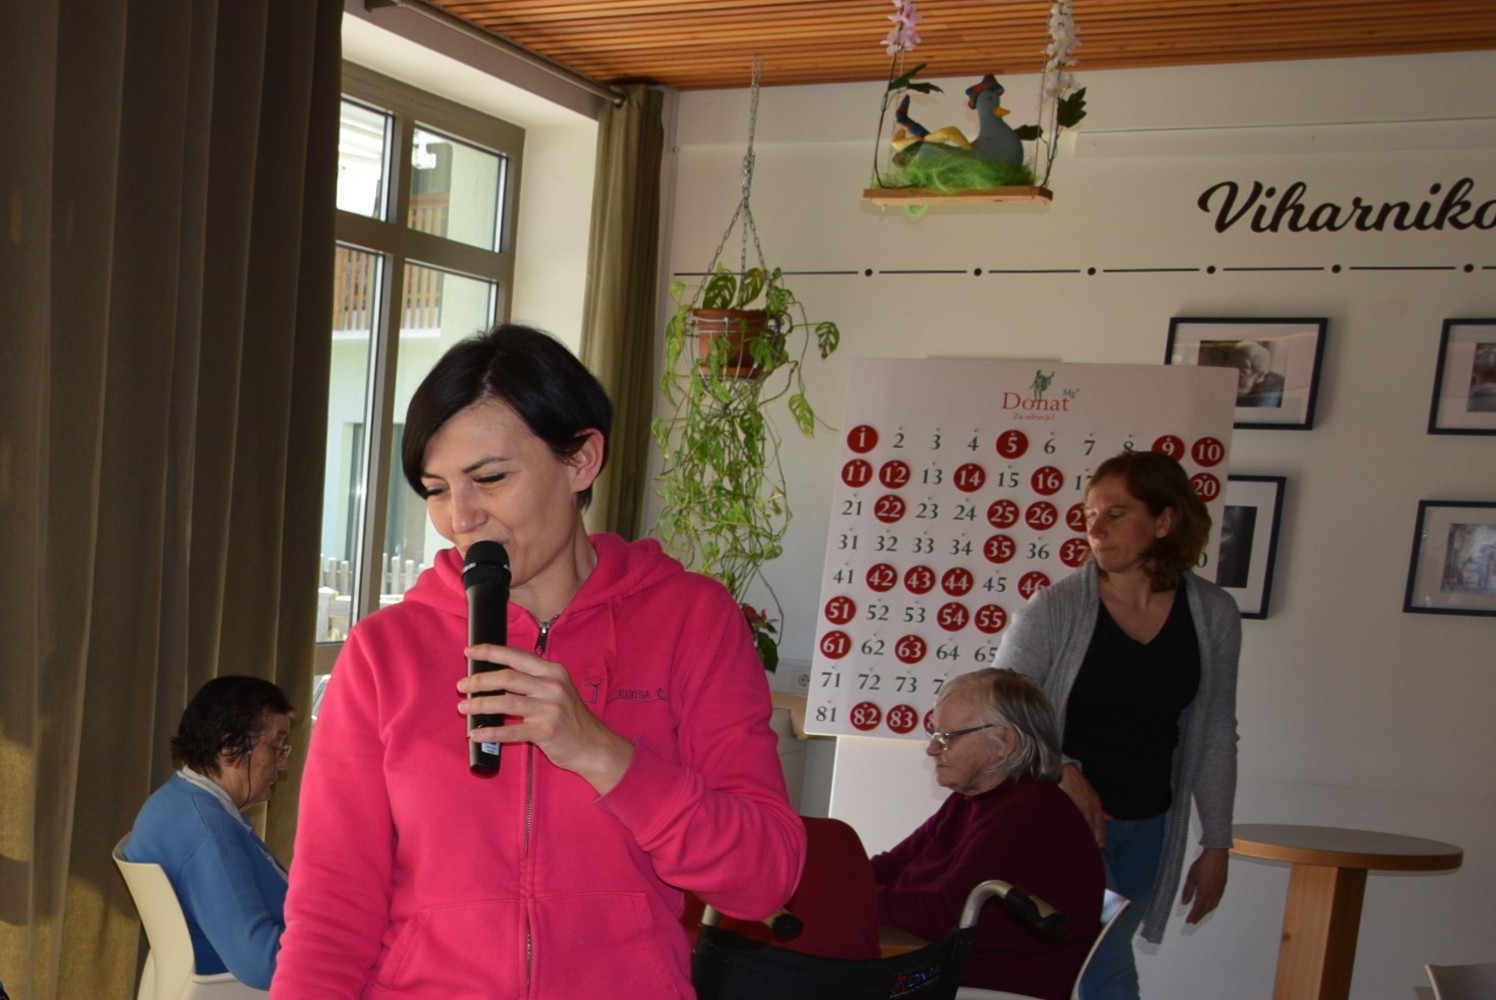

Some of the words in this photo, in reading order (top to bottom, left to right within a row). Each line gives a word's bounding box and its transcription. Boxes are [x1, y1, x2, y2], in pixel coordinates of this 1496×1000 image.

[1002, 392, 1070, 411] Donat
[858, 431, 866, 448] 1
[892, 432, 905, 449] 2
[930, 434, 941, 450] 3
[968, 435, 980, 451] 4
[1006, 436, 1018, 453] 5
[1044, 439, 1056, 454] 6
[1083, 440, 1096, 456] 7
[1161, 441, 1175, 456] 9
[1196, 443, 1221, 461] 10
[846, 465, 867, 482] 11
[885, 466, 907, 483] 12
[922, 468, 943, 485] 13
[959, 469, 981, 486] 14
[997, 471, 1020, 488] 15
[1036, 472, 1060, 489] 16
[1193, 478, 1216, 496] 20
[841, 499, 863, 516] 21
[877, 500, 902, 518] 22
[915, 502, 939, 519] 23
[953, 504, 977, 521] 24
[990, 505, 1015, 523] 25
[1028, 507, 1053, 525] 26
[838, 533, 858, 550] 31
[875, 535, 898, 552] 32
[912, 536, 935, 554] 33
[949, 538, 973, 556] 34
[986, 540, 1012, 558] 35
[1025, 543, 1050, 560] 36
[1062, 544, 1088, 562] 37
[832, 569, 854, 584] 41
[868, 569, 894, 587] 42
[907, 571, 932, 588] 43
[944, 573, 970, 591] 44
[982, 576, 1007, 593] 45
[1020, 578, 1046, 595] 46
[827, 602, 850, 619] 51
[865, 604, 890, 621] 52
[903, 606, 926, 623] 53
[941, 608, 965, 626] 54
[977, 610, 1003, 628] 55
[823, 636, 845, 654] 61
[861, 639, 886, 656] 62
[897, 641, 922, 659] 63
[936, 643, 961, 661] 64
[974, 646, 998, 663] 65
[821, 671, 842, 688] 71
[857, 673, 881, 691] 72
[895, 676, 918, 693] 73
[815, 706, 837, 723] 81
[853, 707, 879, 725] 82
[889, 710, 914, 729] 83
